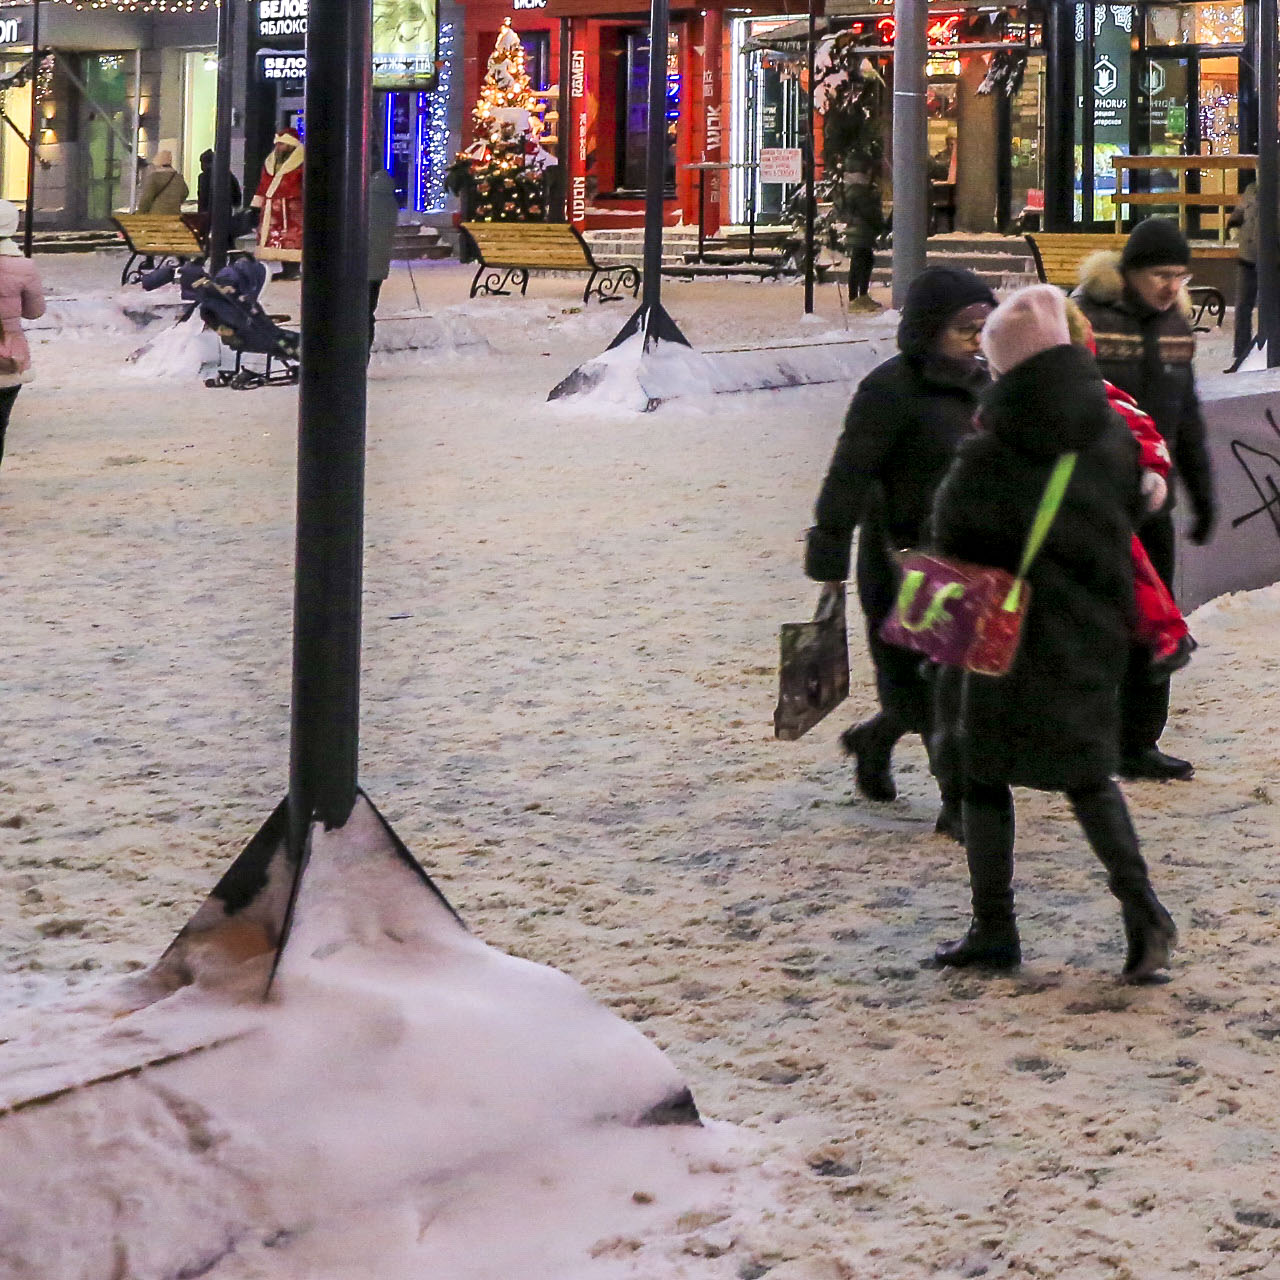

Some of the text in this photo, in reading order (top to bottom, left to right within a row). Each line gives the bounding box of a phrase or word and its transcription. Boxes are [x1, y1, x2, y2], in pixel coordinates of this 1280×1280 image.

[264, 57, 307, 69] БЕЛО
[264, 68, 307, 79] ЯБЛОК
[571, 51, 585, 97] RAMEN
[1094, 98, 1128, 109] PHORUS
[706, 104, 721, 151] WOK
[572, 177, 586, 222] UDON
